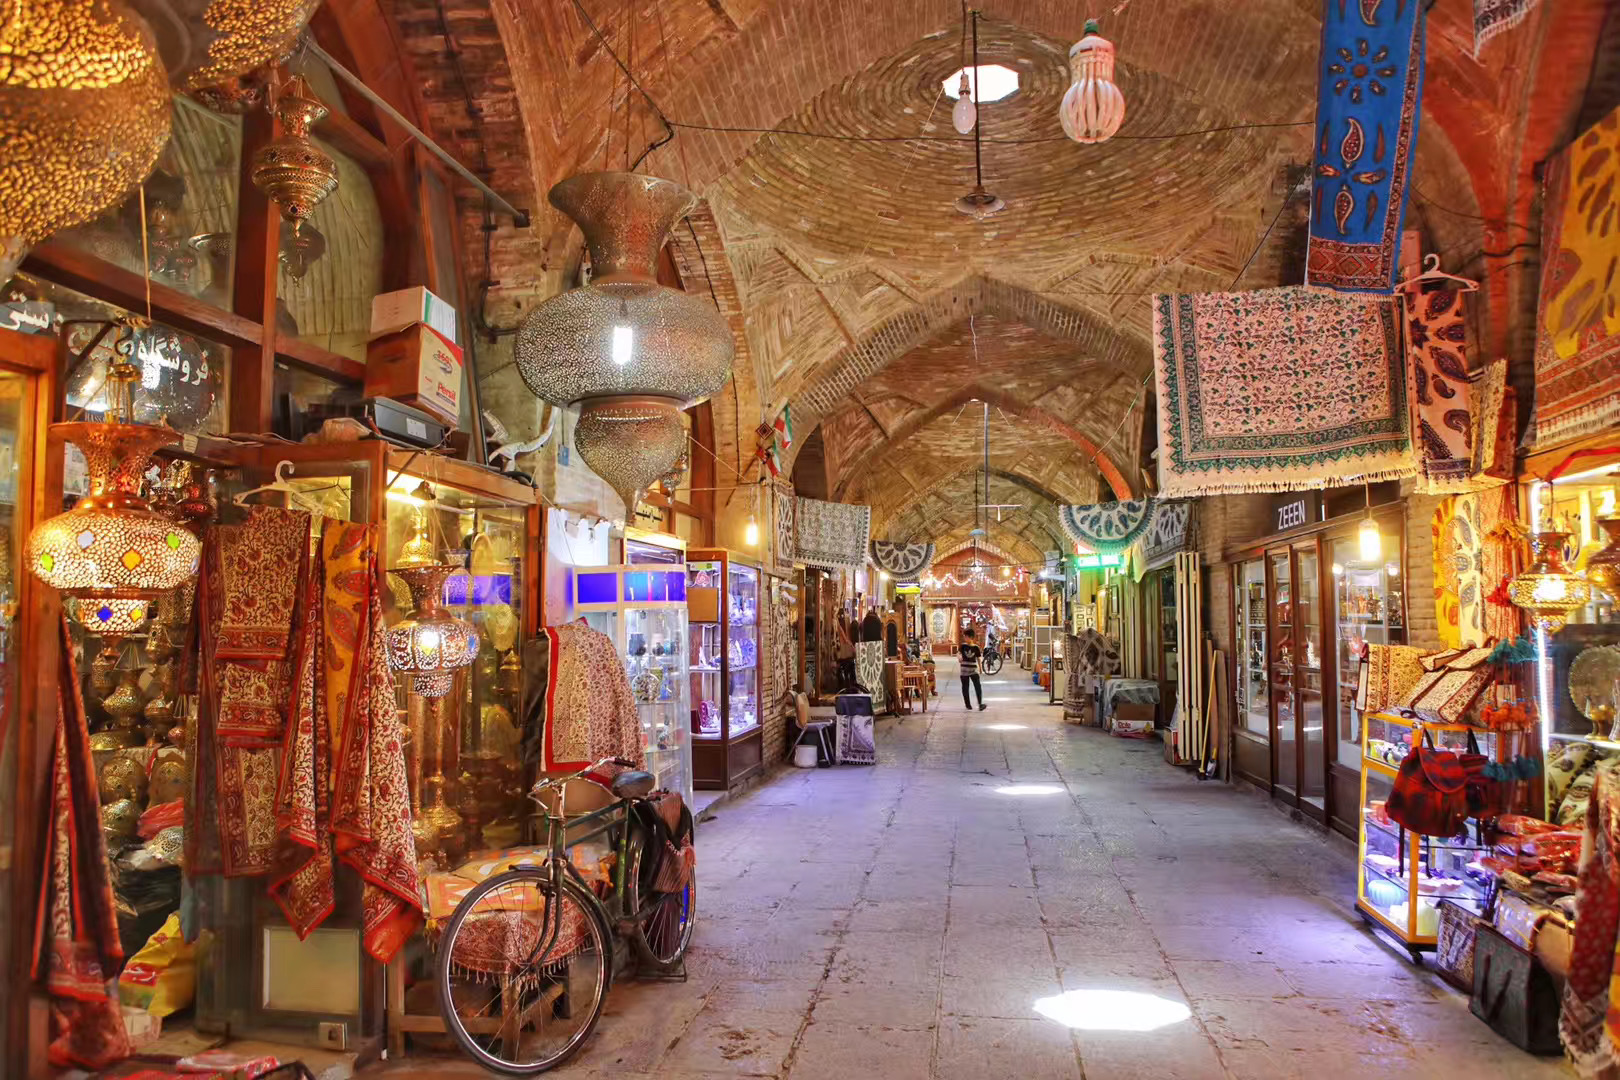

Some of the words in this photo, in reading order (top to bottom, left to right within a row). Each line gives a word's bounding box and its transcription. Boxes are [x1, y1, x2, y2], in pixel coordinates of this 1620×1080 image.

[138, 334, 209, 386] فروشگاه
[437, 382, 457, 401] Persil
[1278, 499, 1305, 530] ZEEEN
[1117, 721, 1131, 729] Dole
